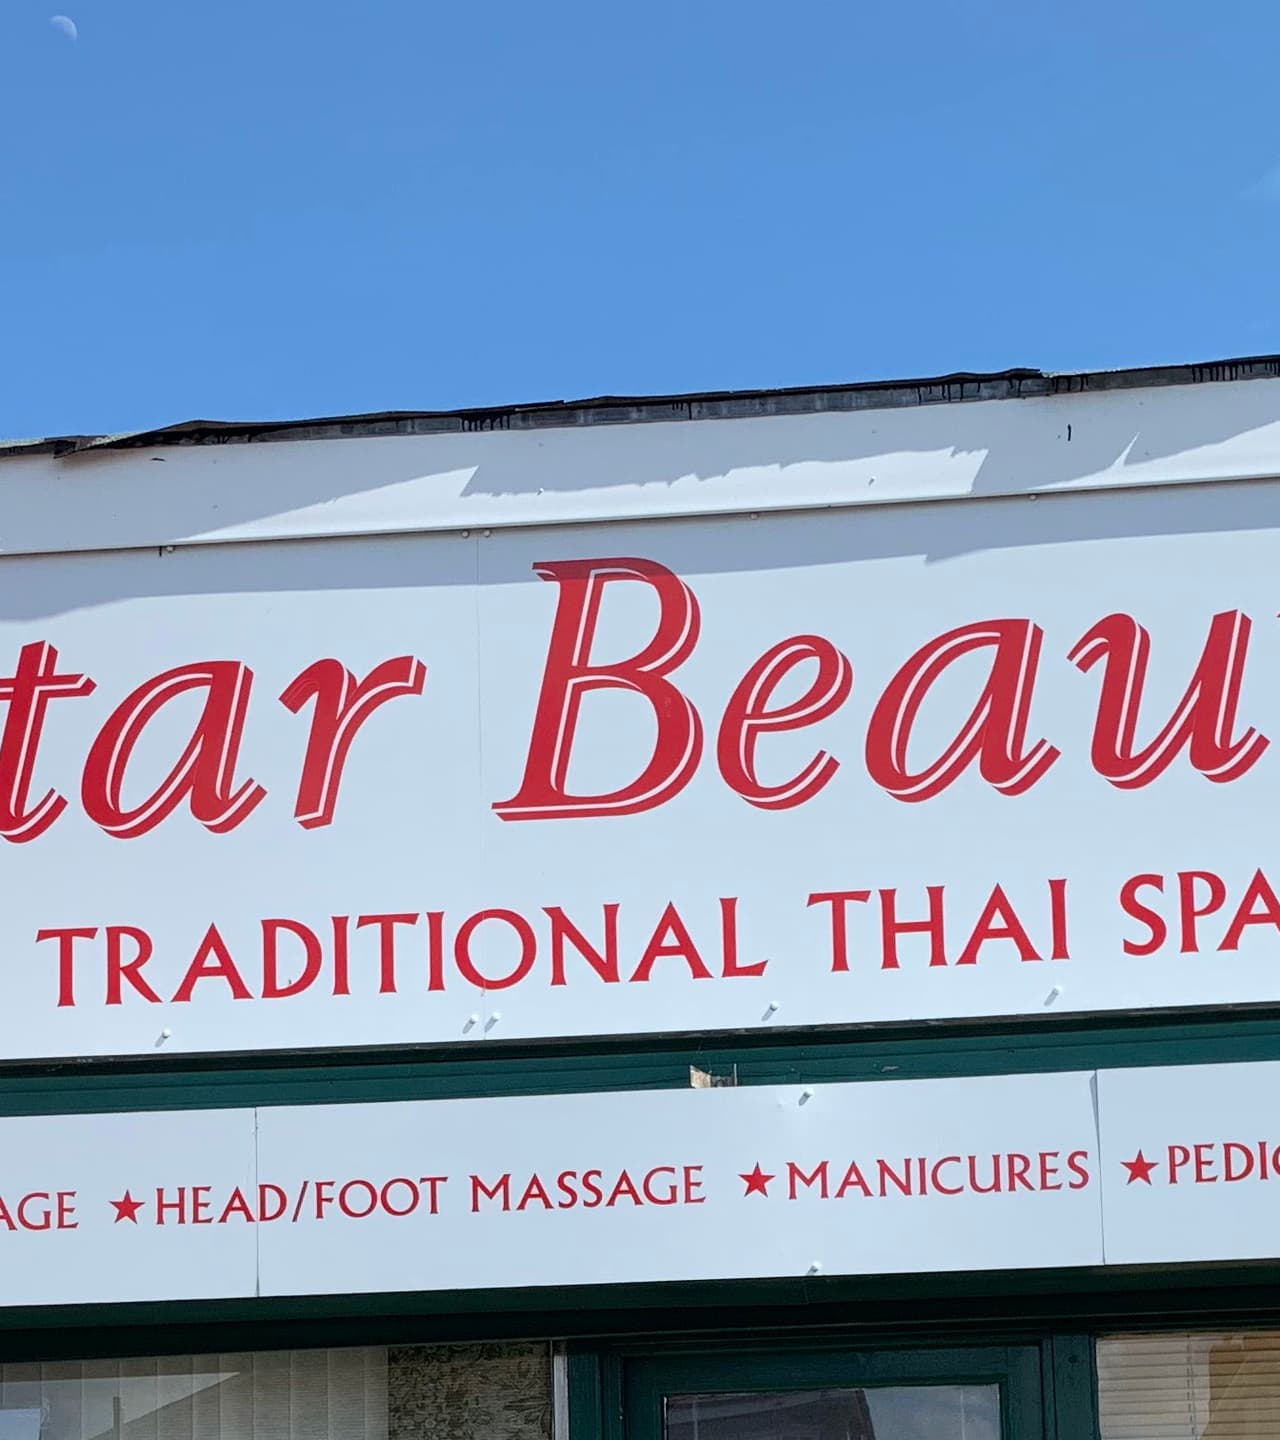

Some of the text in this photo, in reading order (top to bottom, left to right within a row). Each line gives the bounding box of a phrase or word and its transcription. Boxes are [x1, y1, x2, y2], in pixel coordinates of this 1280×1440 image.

[36, 897, 768, 1007] TRADITIONAL
[807, 878, 1070, 972] THAI
[156, 1175, 450, 1226] HEAD/FOOT
[470, 1165, 708, 1212] MASSAGE
[787, 1150, 1089, 1200] MANICURES
